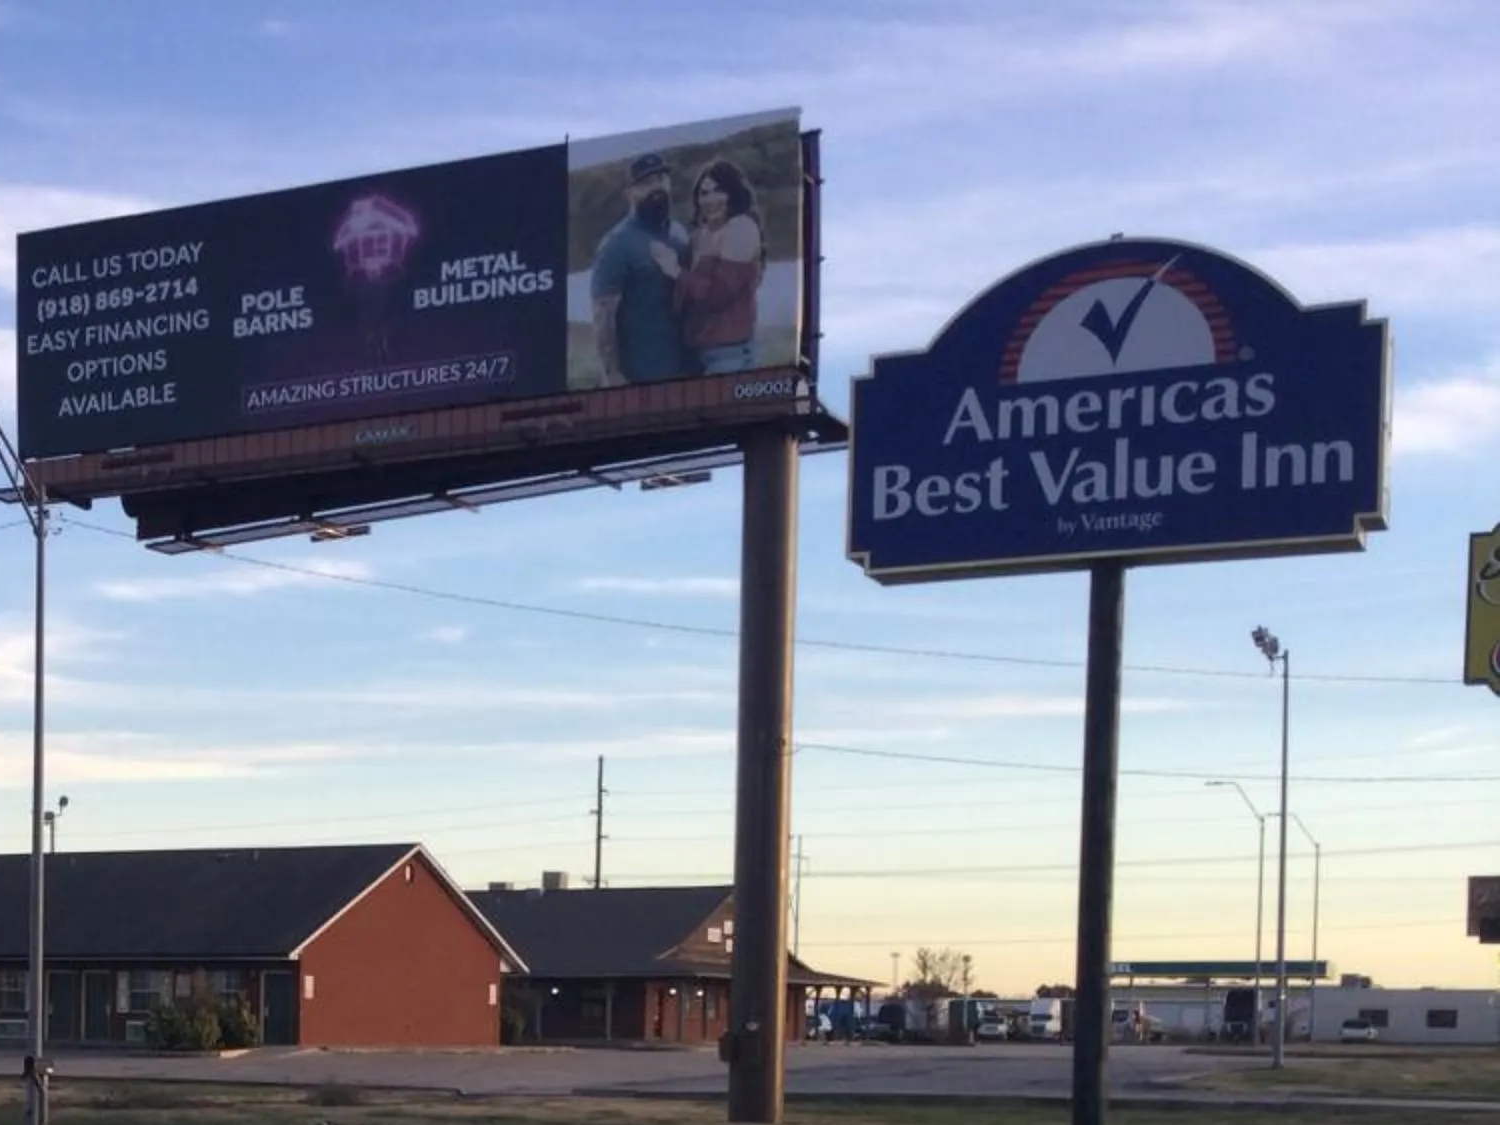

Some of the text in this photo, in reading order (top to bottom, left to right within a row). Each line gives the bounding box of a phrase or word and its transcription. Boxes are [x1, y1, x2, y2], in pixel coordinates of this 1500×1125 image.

[31, 241, 204, 289] CALL US TODAY
[440, 249, 527, 283] METAL
[36, 292, 90, 323] (918)
[241, 285, 305, 315] POLE
[413, 269, 554, 311] BUILDINGS
[27, 308, 210, 356] EASY FINANCING
[232, 308, 314, 339] BARNS
[67, 349, 168, 383] OPTIONS
[246, 356, 510, 410] AMAZING STRUCTURES 24/7
[57, 382, 177, 417] AVAILABLE
[942, 370, 1277, 446] Americas
[872, 430, 1355, 521] Best Value Inn
[1057, 510, 1165, 537] by Vantage
